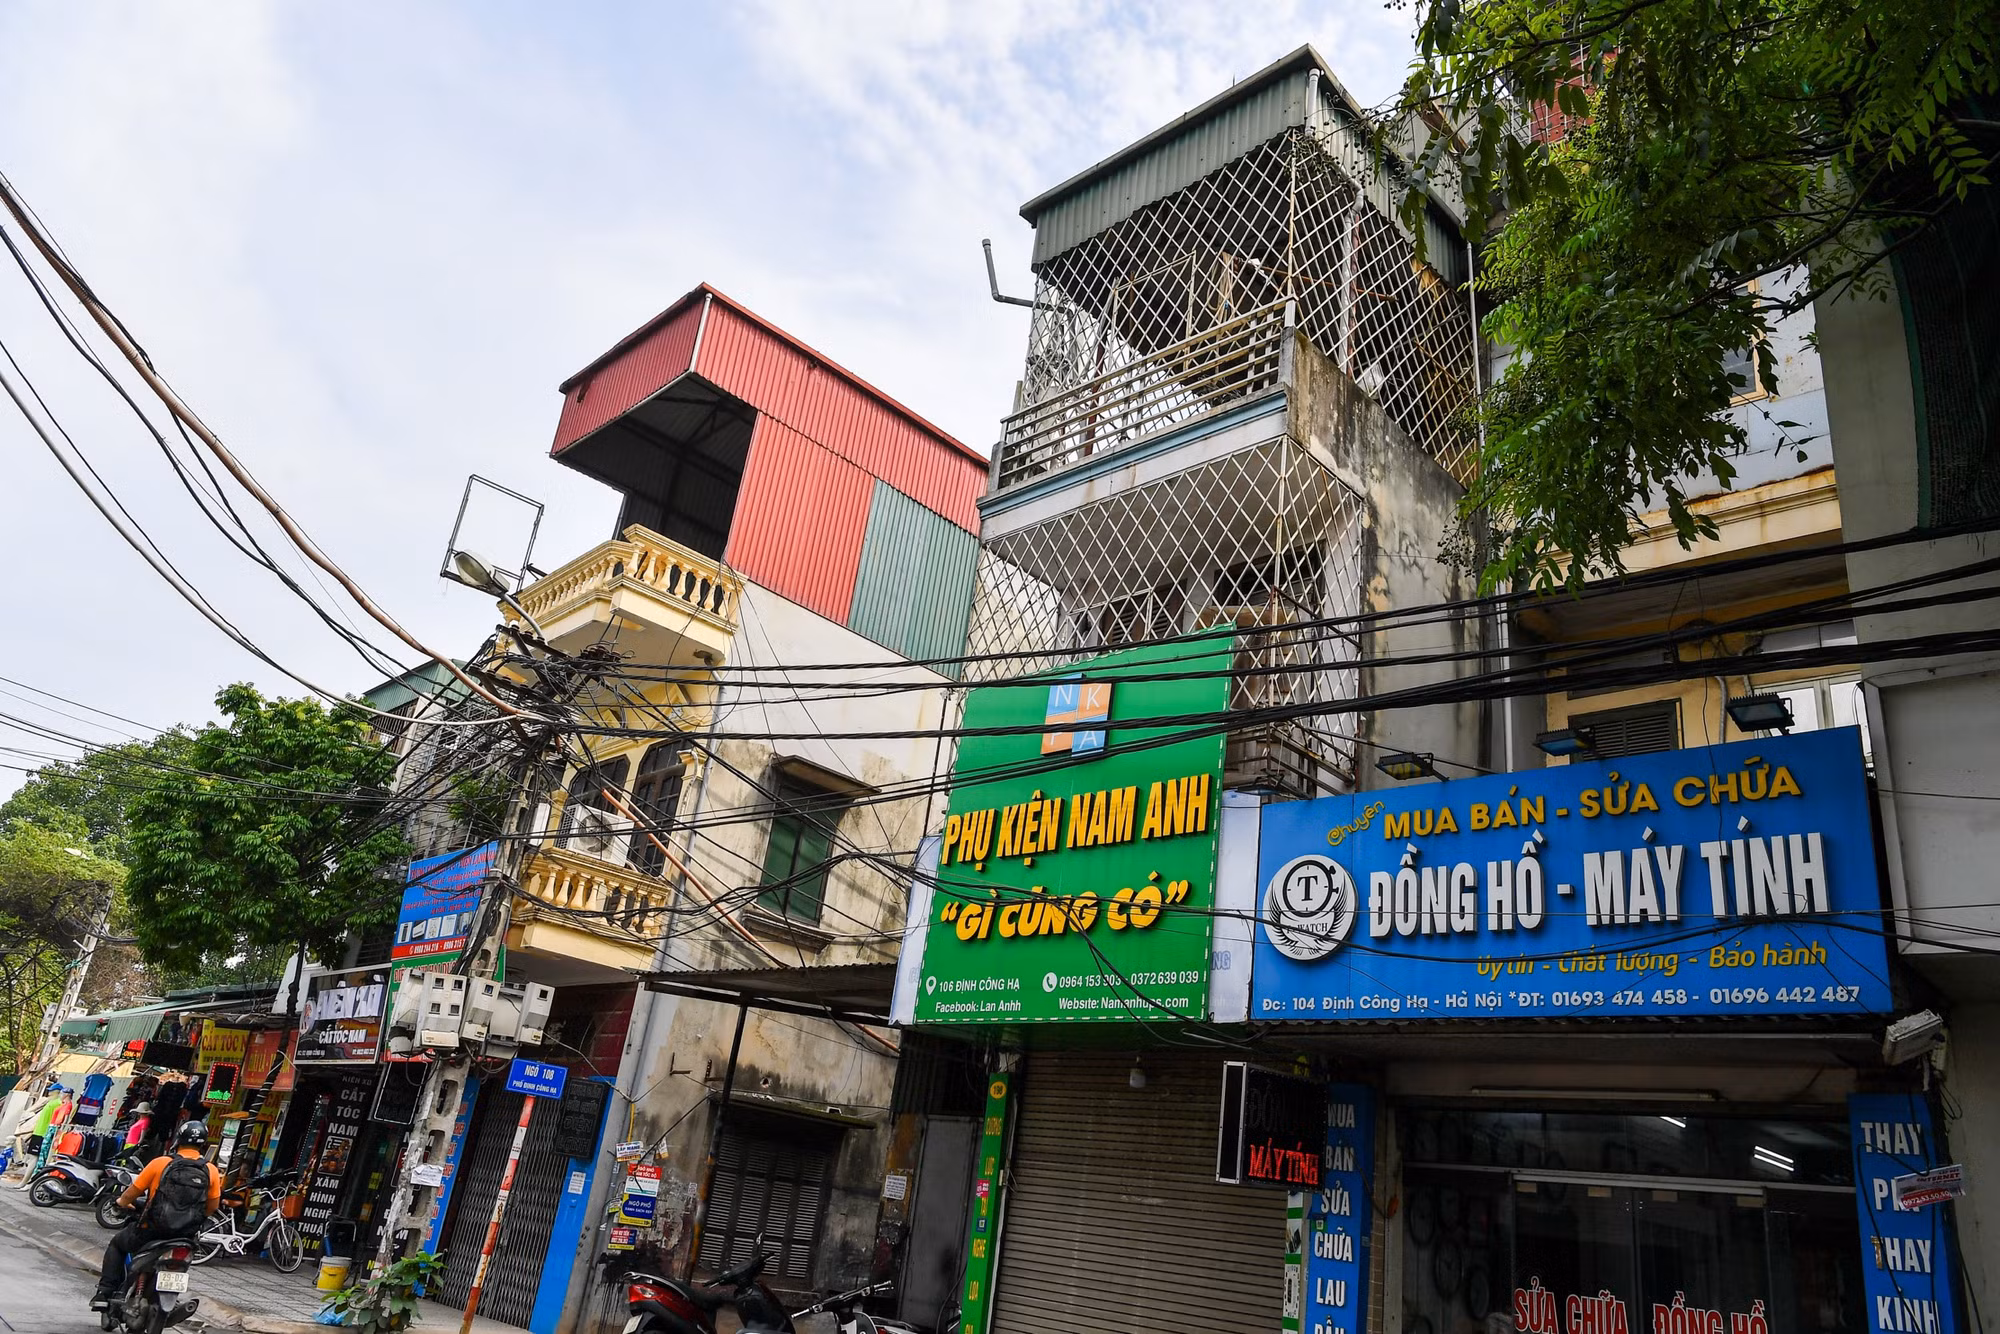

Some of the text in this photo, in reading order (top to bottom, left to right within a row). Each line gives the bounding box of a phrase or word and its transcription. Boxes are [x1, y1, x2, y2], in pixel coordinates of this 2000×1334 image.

[1327, 800, 1385, 846] Chuyên
[1384, 806, 1459, 840] MUA
[1470, 785, 1545, 831] BÁN
[1579, 771, 1659, 818] SỬA
[1673, 756, 1802, 807] CHỮA
[941, 773, 1212, 872] PHỤ KIỆN NAM ANH
[1297, 875, 1319, 902] T
[1368, 842, 1479, 938] ĐỒNG
[1488, 829, 1545, 931] HỒ
[1583, 826, 1685, 927] MÁY
[1700, 816, 1831, 920] TÍNH
[998, 885, 1100, 939] CŨNG
[1615, 951, 1679, 977] lượng
[1709, 941, 1756, 969] Bảo
[1763, 941, 1827, 967] hành
[939, 976, 1021, 993] 106 ĐỊNH CÔNG HẠ
[1059, 976, 1083, 989] 0964
[1084, 975, 1101, 987] 153
[1130, 972, 1156, 986] 0372
[1156, 971, 1177, 985] 639
[1178, 970, 1200, 984] 039
[935, 999, 1022, 1013] Facebook: Lan Anhh
[1058, 997, 1100, 1010] Website:
[1262, 998, 1287, 1012] Đc:
[1292, 997, 1316, 1011] 104
[1322, 995, 1355, 1011] Định
[1359, 994, 1401, 1013] Công
[1406, 994, 1429, 1010] Hạ
[1445, 990, 1469, 1009] Hà
[1475, 990, 1503, 1009] Nội
[1551, 992, 1605, 1007] 01693
[1611, 991, 1645, 1006] 474
[1651, 989, 1689, 1005] 458
[1709, 987, 1770, 1004] 01696
[1775, 986, 1817, 1003] 442
[1821, 985, 1861, 1003] 487
[348, 1028, 368, 1044] NAM
[340, 1086, 366, 1103] CẮT
[336, 1105, 361, 1120] TÓC
[328, 1122, 360, 1137] NAM
[1860, 1121, 1922, 1156] THAY
[1248, 1137, 1319, 1185] MÁY TÍNH
[1325, 1140, 1354, 1172] BÁN
[309, 1190, 336, 1204] HÌNH
[314, 1176, 339, 1190] XĂM
[1320, 1180, 1351, 1217] SỬA
[1313, 1226, 1353, 1262] CHỮA
[1871, 1236, 1932, 1274] THAY
[1316, 1277, 1346, 1308] LAU
[1513, 1276, 1768, 1334] SỬA CHỮA ĐỒNG HỒ
[1876, 1286, 1941, 1334] KÍNH
